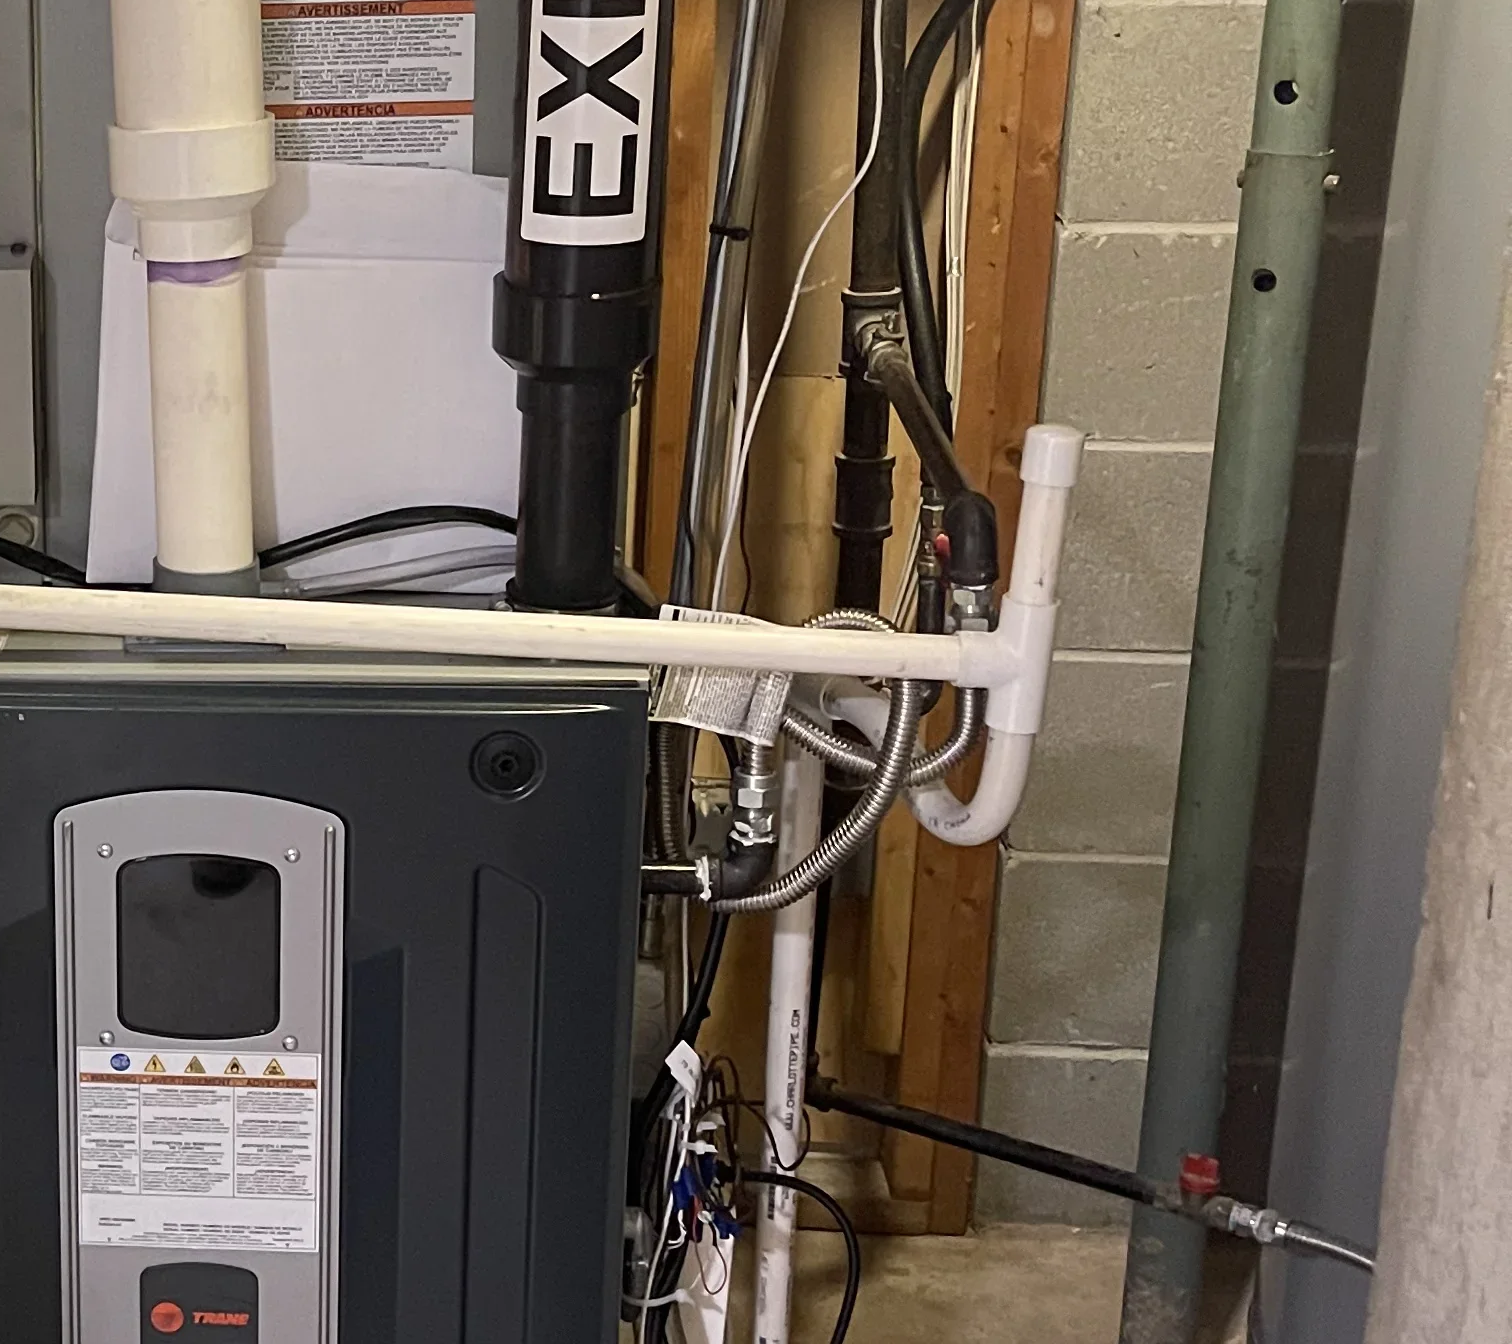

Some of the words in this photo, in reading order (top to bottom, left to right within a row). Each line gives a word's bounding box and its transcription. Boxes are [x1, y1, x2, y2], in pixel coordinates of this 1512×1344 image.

[298, 2, 404, 16] AVERTISSEMENT
[305, 105, 395, 117] ADVERTENCIA
[192, 1311, 249, 1325] TRANE
